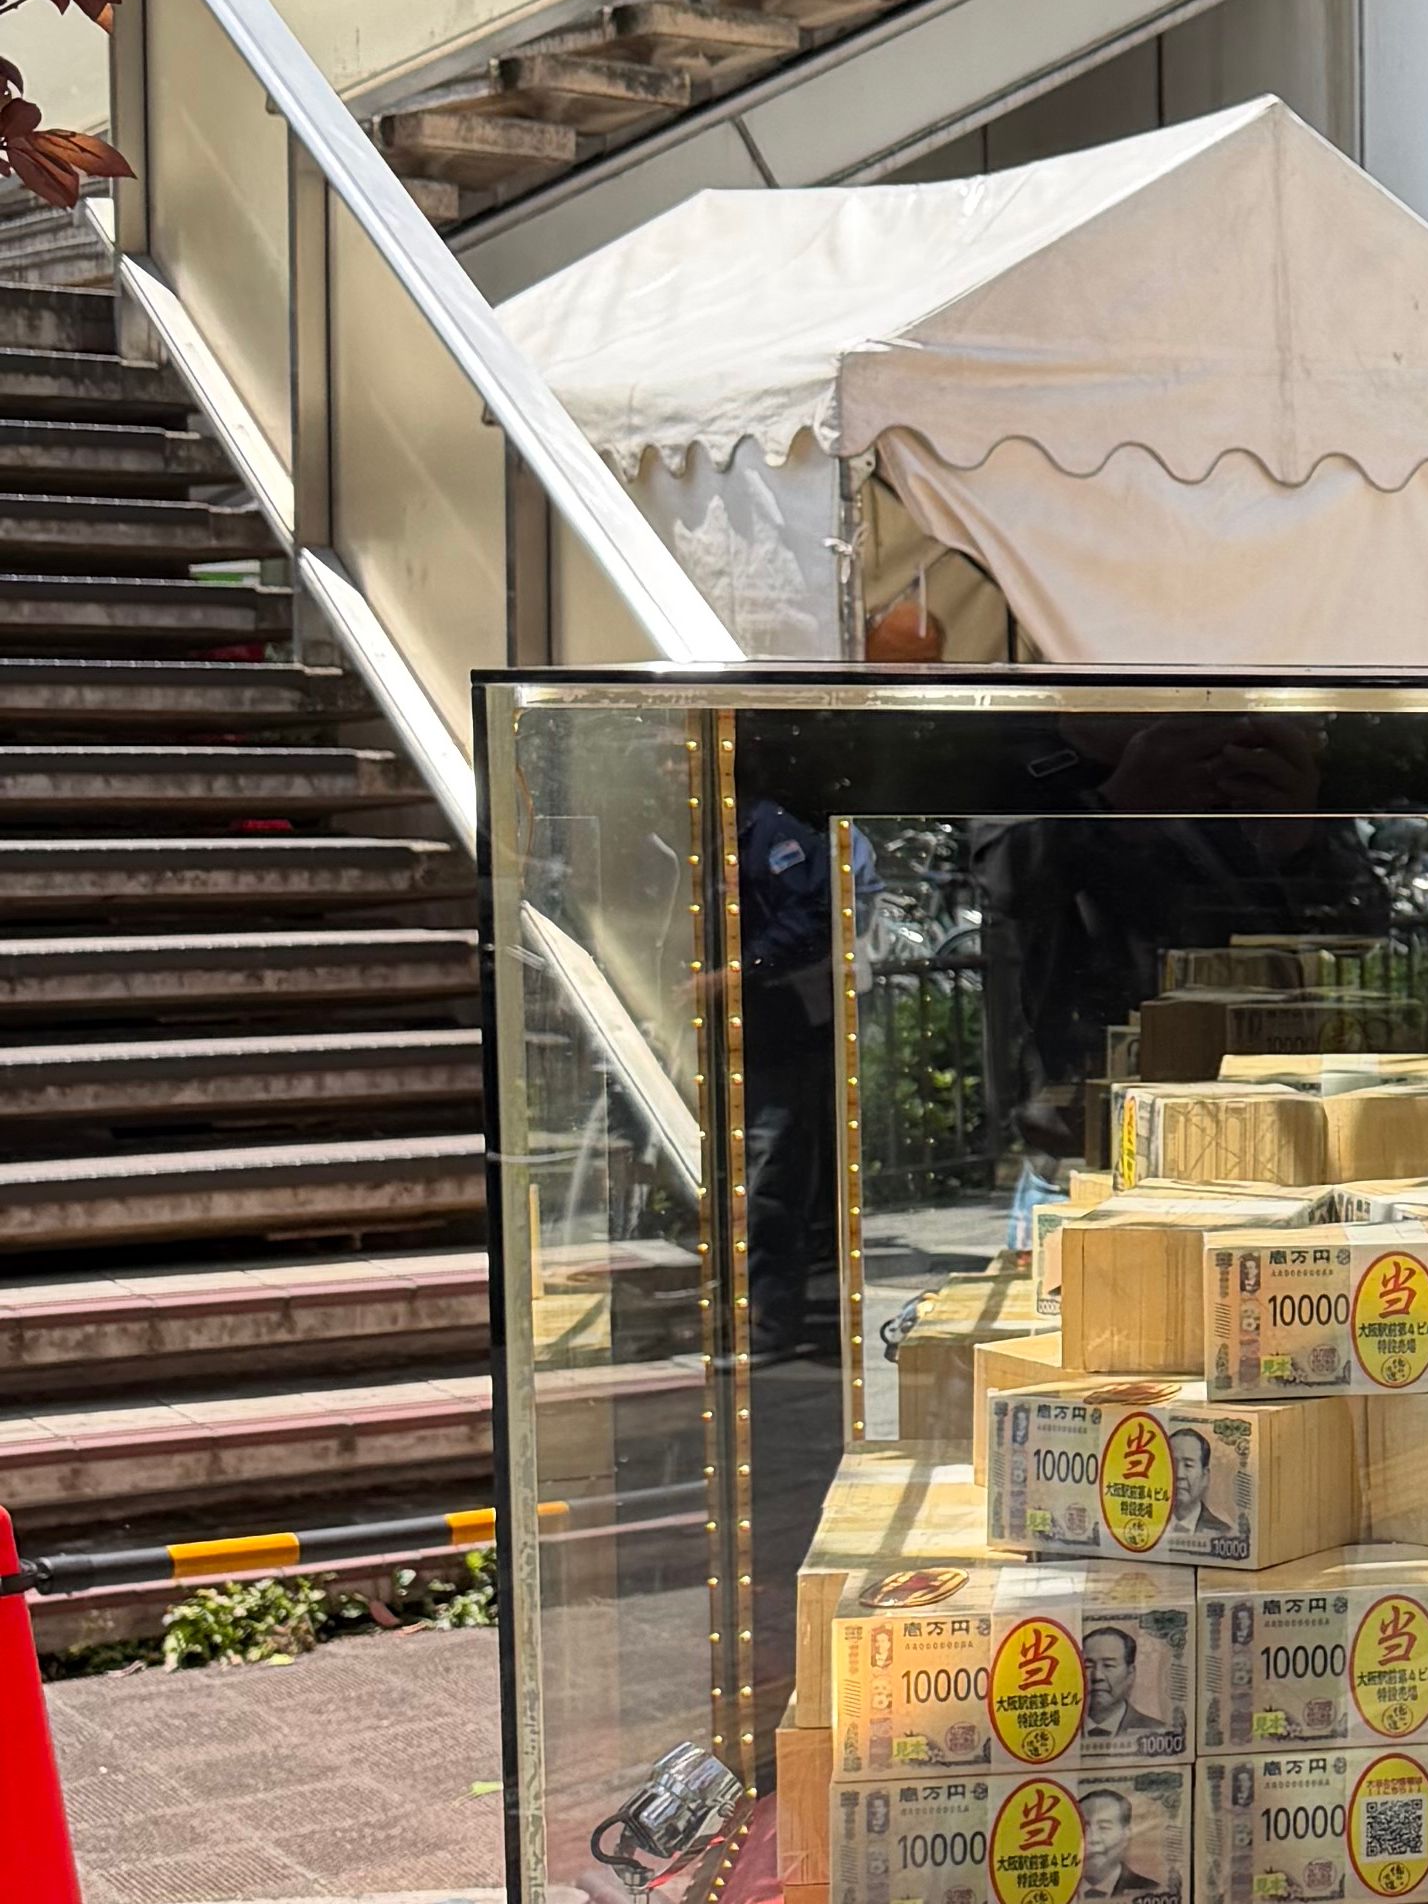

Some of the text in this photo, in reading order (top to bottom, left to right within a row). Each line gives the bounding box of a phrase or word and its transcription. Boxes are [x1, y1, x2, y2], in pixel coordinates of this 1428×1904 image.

[1378, 1261, 1417, 1318] 当
[1268, 1294, 1350, 1327] 10000
[1034, 1449, 1098, 1485] 10000
[1123, 1423, 1156, 1479] 当
[1378, 1606, 1417, 1666] 当
[1018, 1628, 1060, 1692] 当
[1261, 1644, 1346, 1680] 10000
[902, 1667, 989, 1705] 10000
[1019, 1790, 1060, 1850] 当
[1262, 1804, 1345, 1841] 10000
[898, 1831, 987, 1869] 10000
